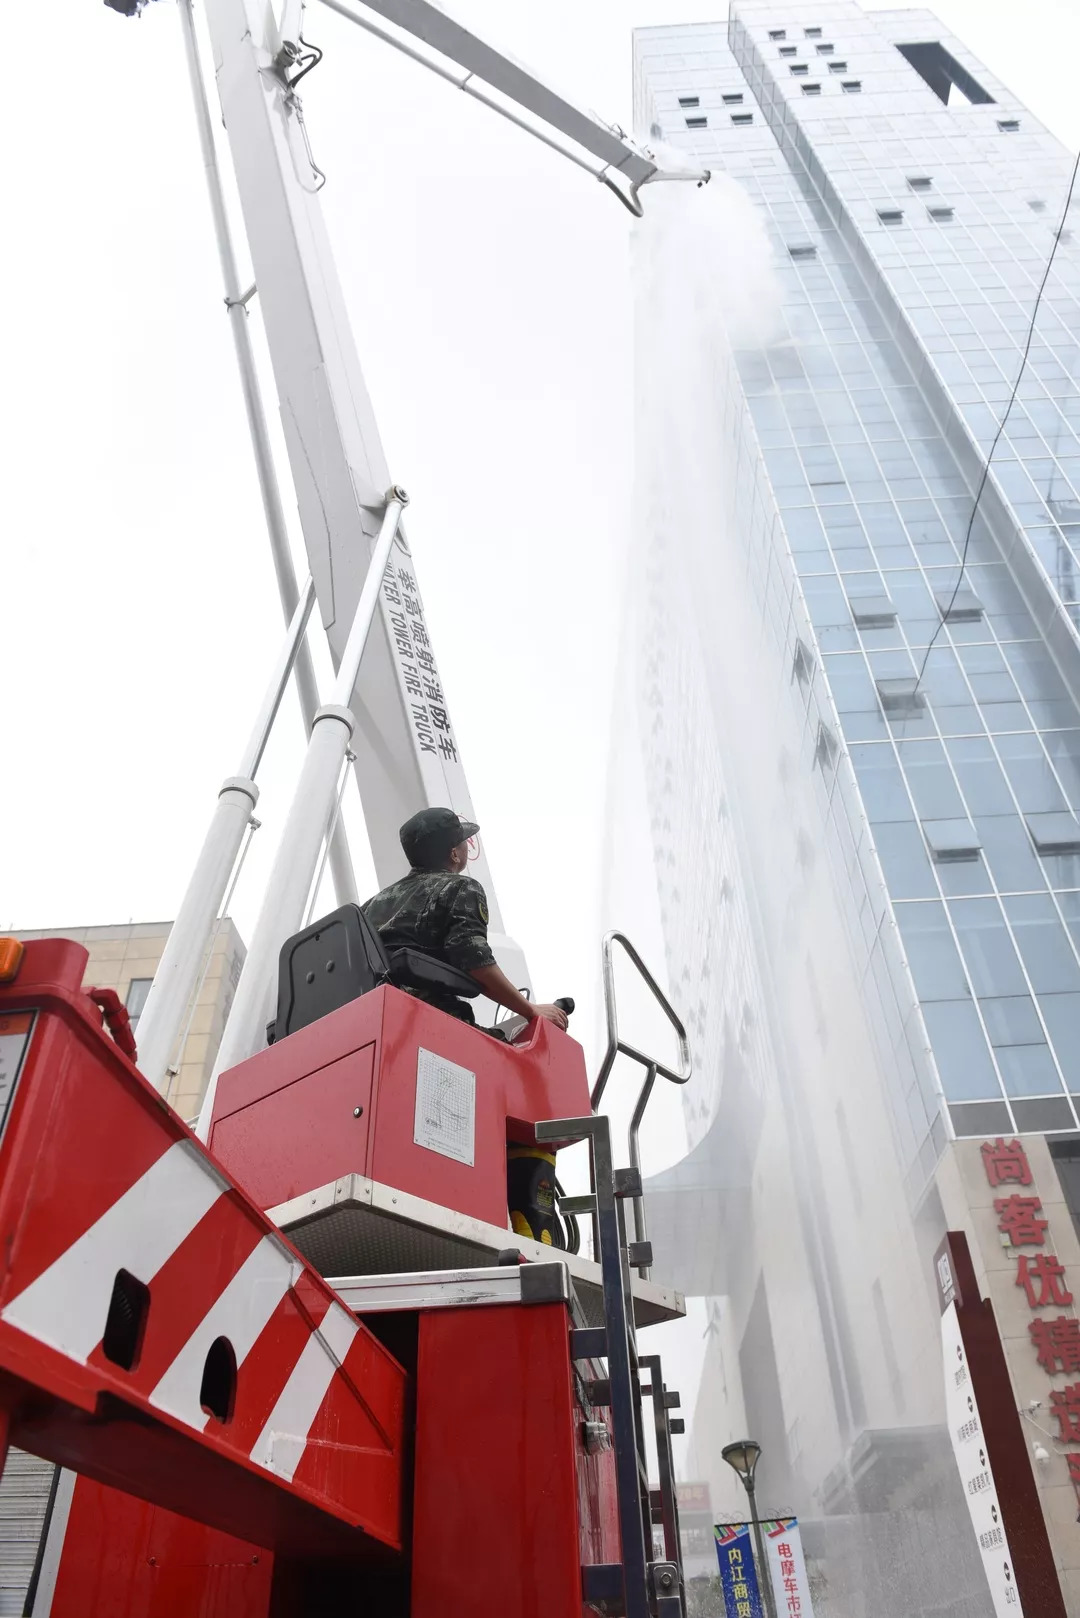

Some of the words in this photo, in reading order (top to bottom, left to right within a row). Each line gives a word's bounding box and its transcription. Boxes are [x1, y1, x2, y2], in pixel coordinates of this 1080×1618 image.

[389, 609, 414, 659] TOWER
[397, 567, 458, 763] 举高喷射消防车
[401, 662, 424, 698] FIRE
[411, 703, 438, 756] TRUCK
[979, 1136, 1080, 1515] 尚客优精选
[727, 1547, 752, 1618] 内江商贸
[777, 1542, 803, 1618] 电摩车市
